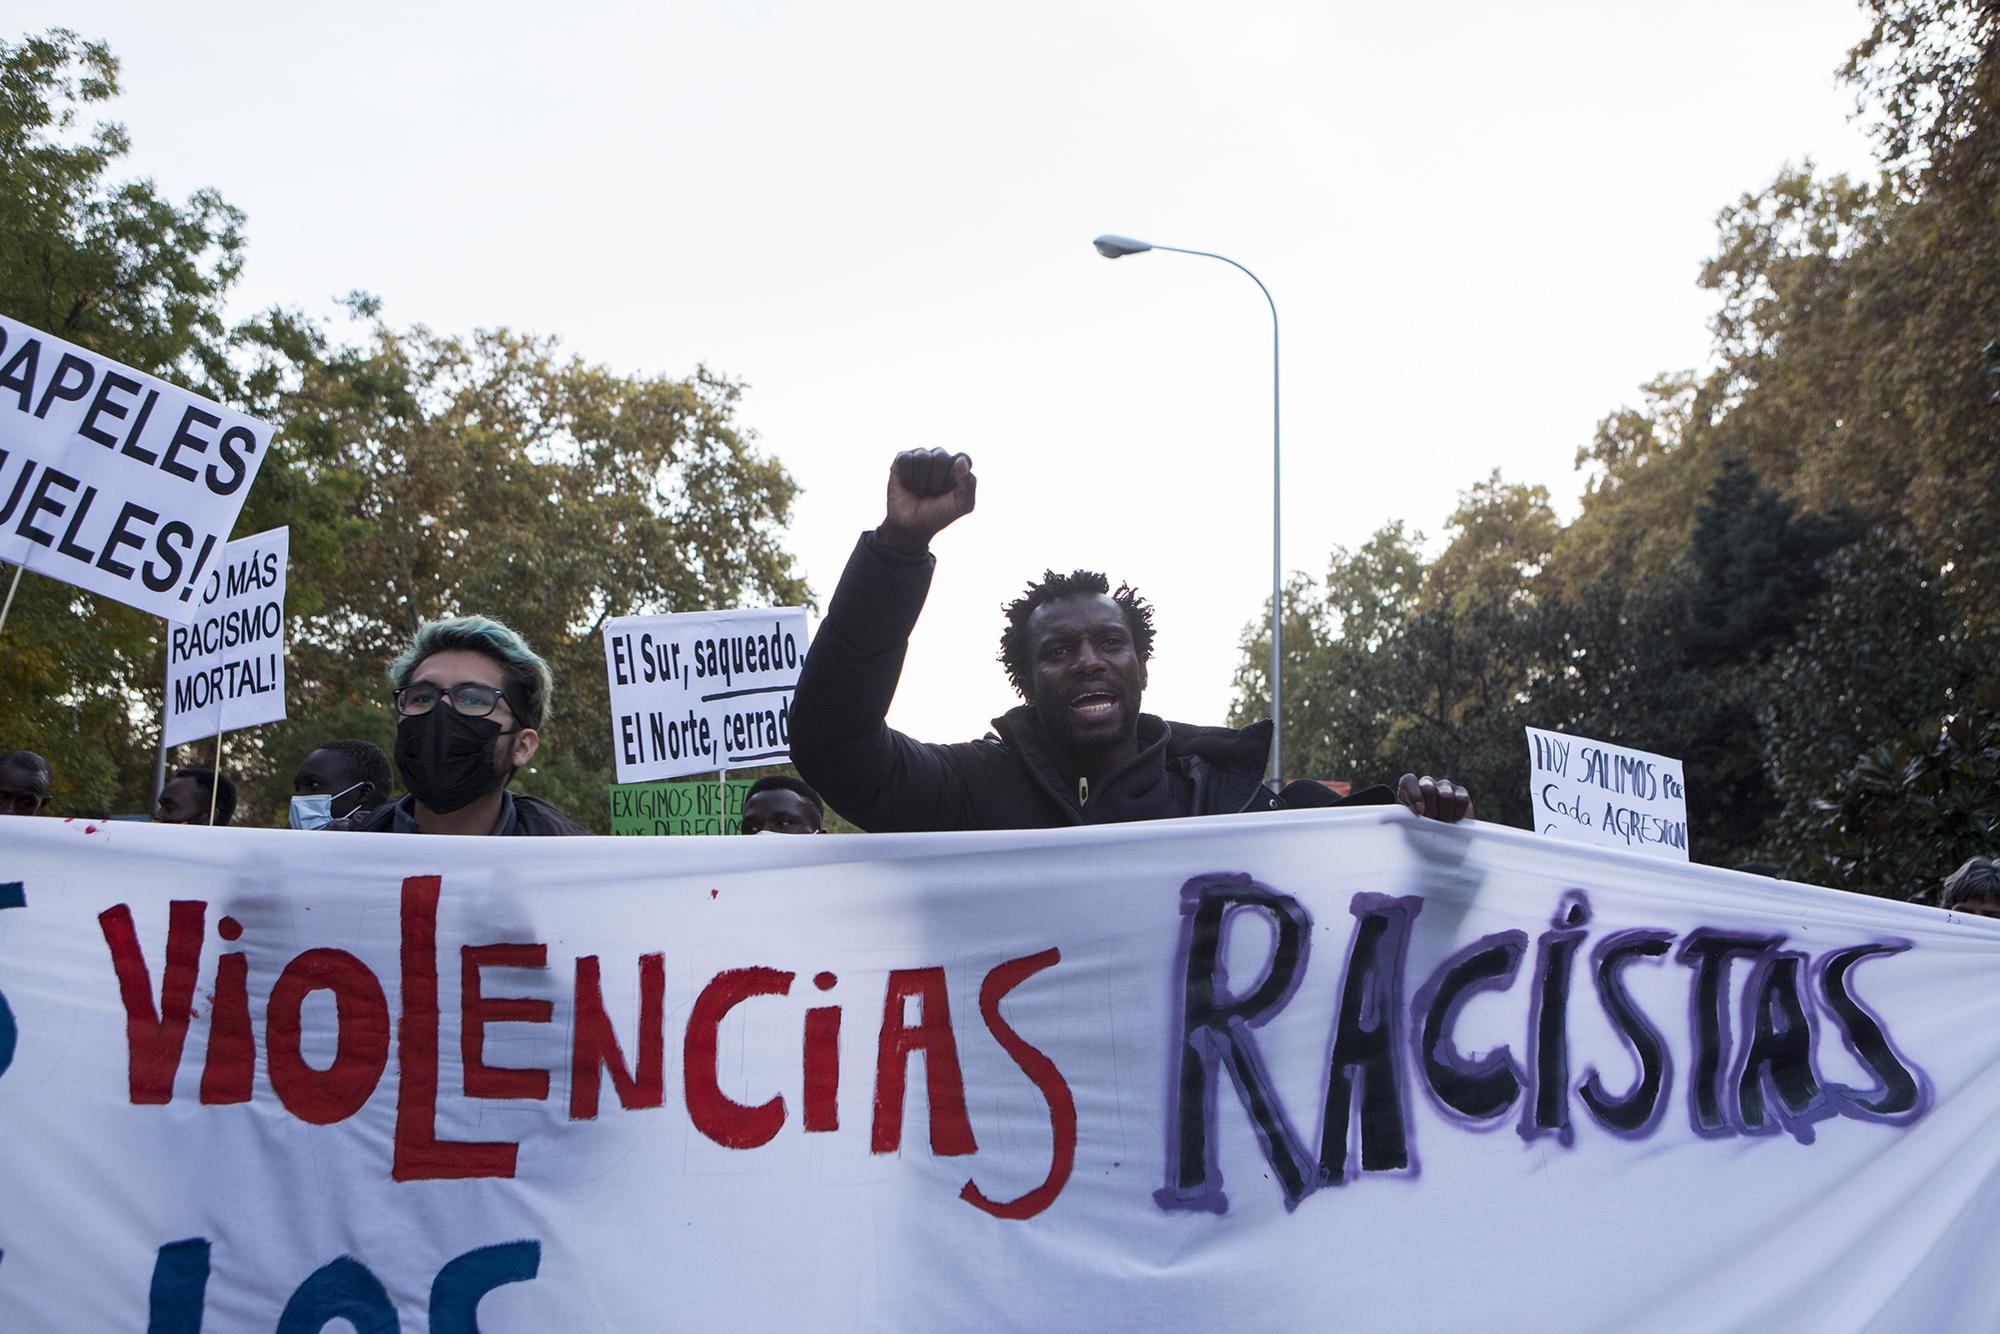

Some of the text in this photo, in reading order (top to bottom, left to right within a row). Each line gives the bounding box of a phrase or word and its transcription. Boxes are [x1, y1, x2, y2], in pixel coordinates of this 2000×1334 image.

[0, 325, 257, 496] APELES
[199, 550, 278, 607] O MÁS
[172, 601, 281, 664] RACISMO
[175, 654, 276, 715] MORTAL!
[612, 633, 636, 685] El
[641, 633, 690, 690] Sur,
[621, 712, 645, 765] El
[650, 709, 718, 765] Norte,
[1534, 734, 1570, 778] HOY
[1577, 747, 1657, 801] SALIMOS
[613, 788, 693, 820] EXIGIMOS
[1542, 783, 1592, 827] Cada
